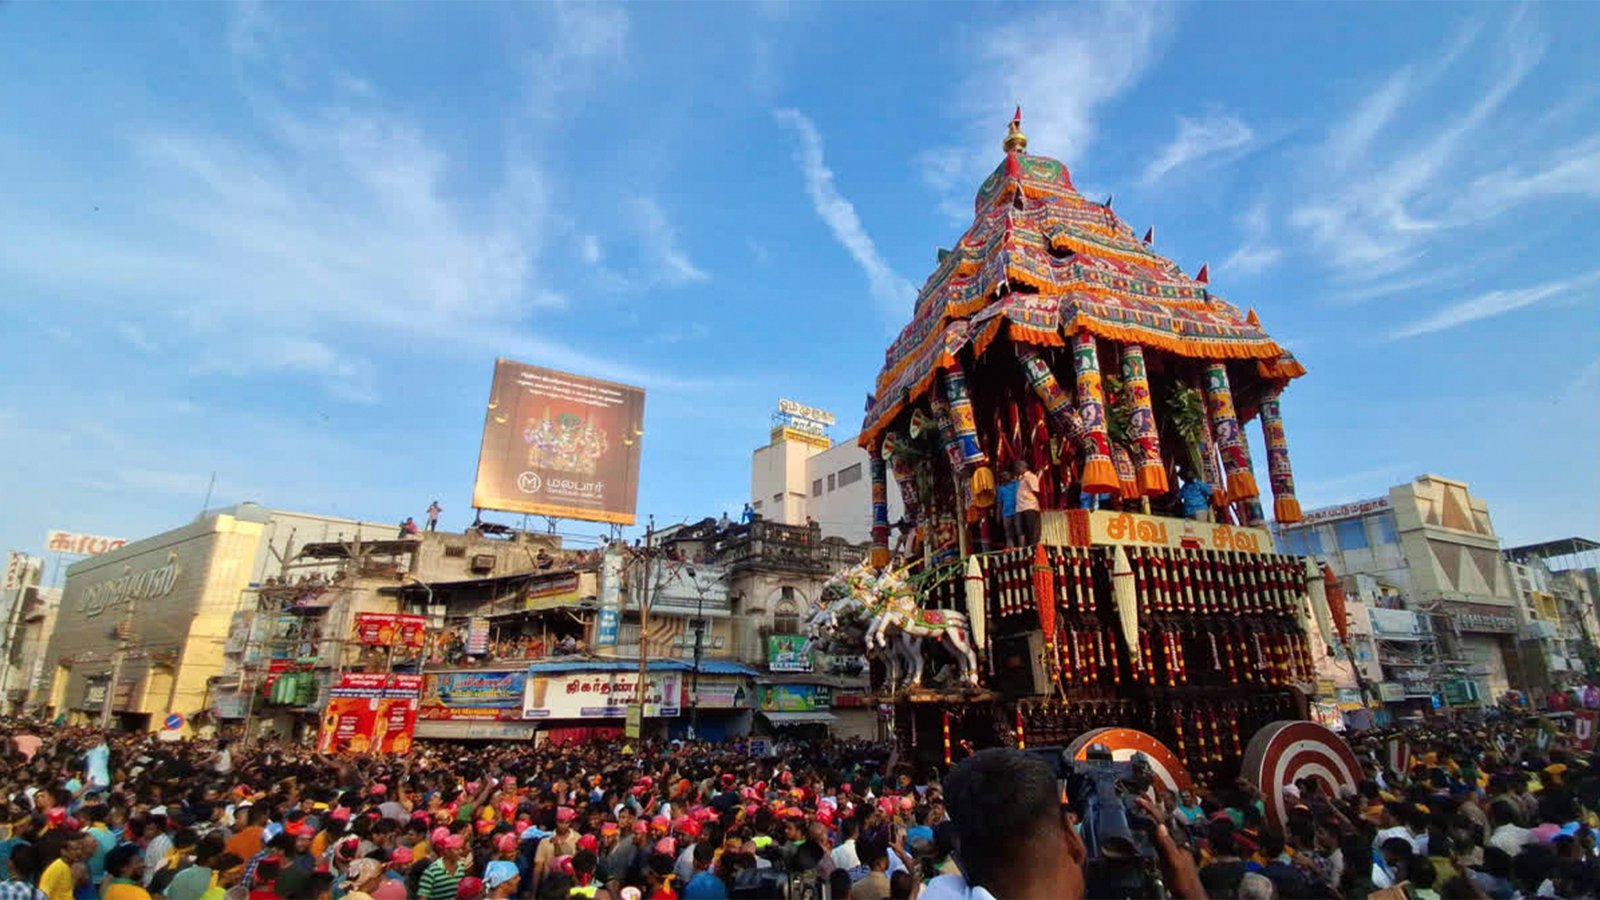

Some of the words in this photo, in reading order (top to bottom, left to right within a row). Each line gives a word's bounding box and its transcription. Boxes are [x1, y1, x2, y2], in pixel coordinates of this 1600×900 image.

[546, 477, 605, 495] மலபார்
[1107, 511, 1168, 544] சிவ
[1211, 523, 1260, 554] சிவ
